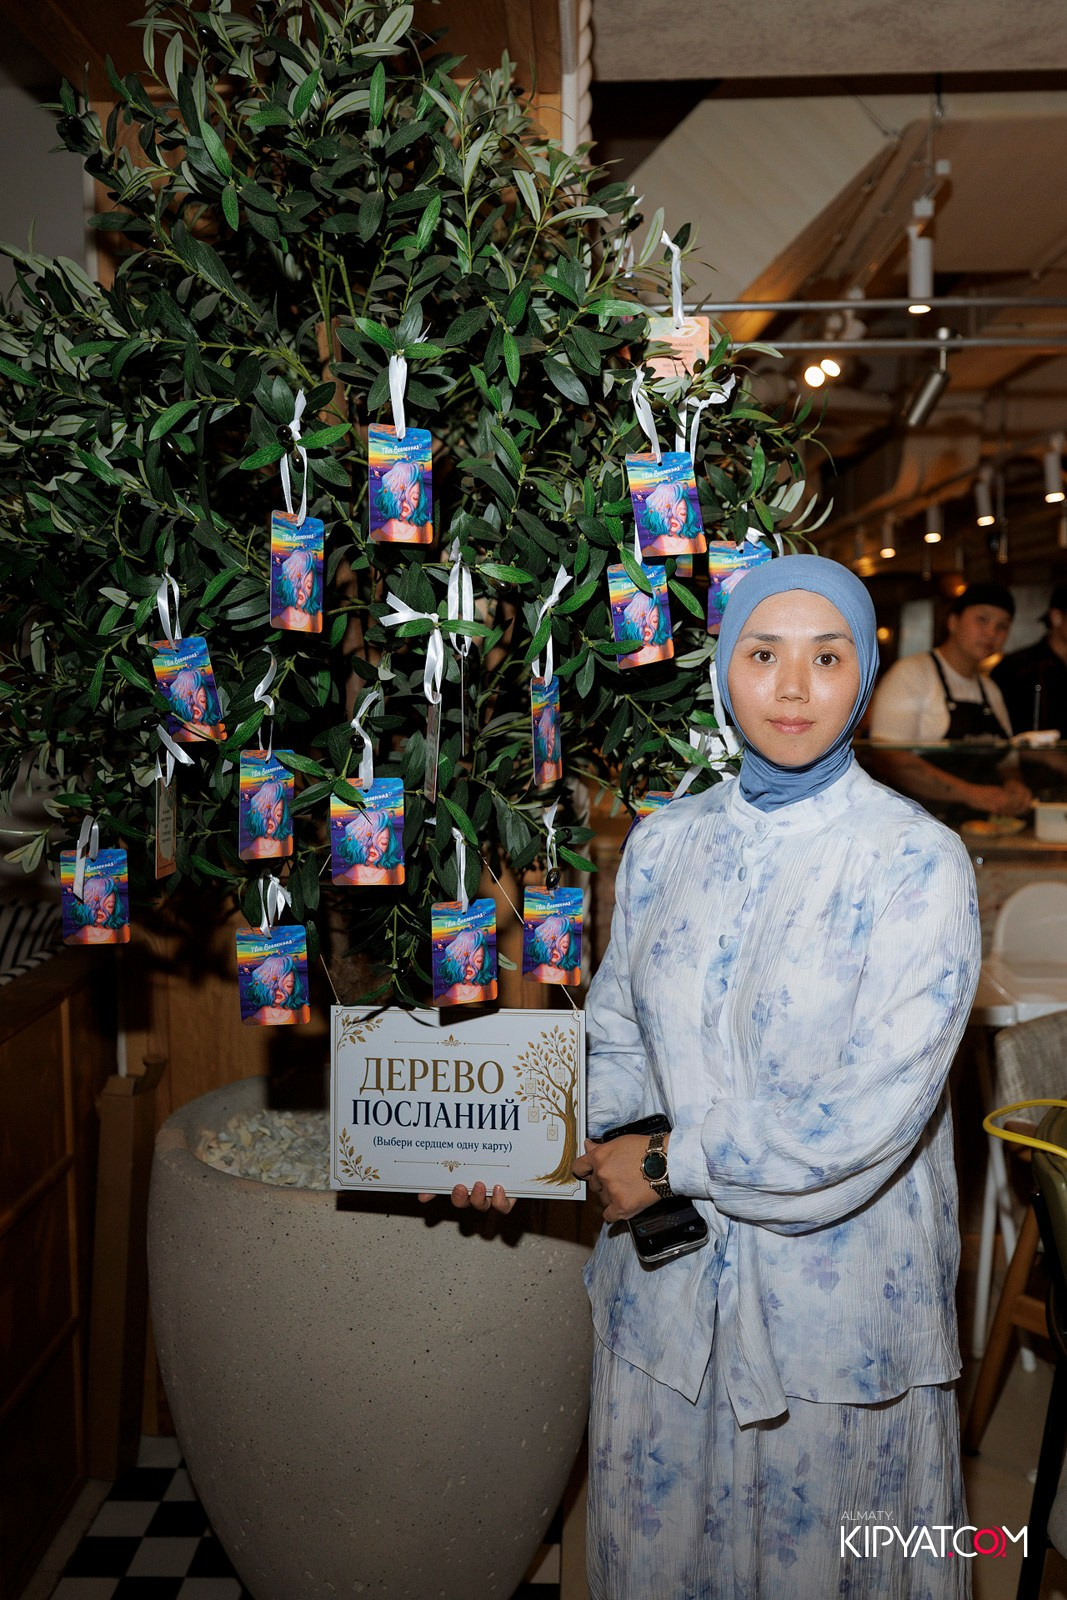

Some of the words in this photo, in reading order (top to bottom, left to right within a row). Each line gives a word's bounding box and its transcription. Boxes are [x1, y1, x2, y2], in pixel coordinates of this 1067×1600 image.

[394, 444, 420, 454] Вселенная
[653, 466, 681, 477] Вселенная
[364, 793, 389, 802] селенная
[264, 940, 292, 950] Вселенная
[360, 1058, 504, 1096] ДЕРЕВО
[352, 1099, 520, 1131] ПОСЛАНИЙ
[373, 1136, 412, 1149] (Выбери
[415, 1139, 454, 1151] сердцем
[456, 1141, 479, 1152] одну
[482, 1141, 513, 1153] карту)
